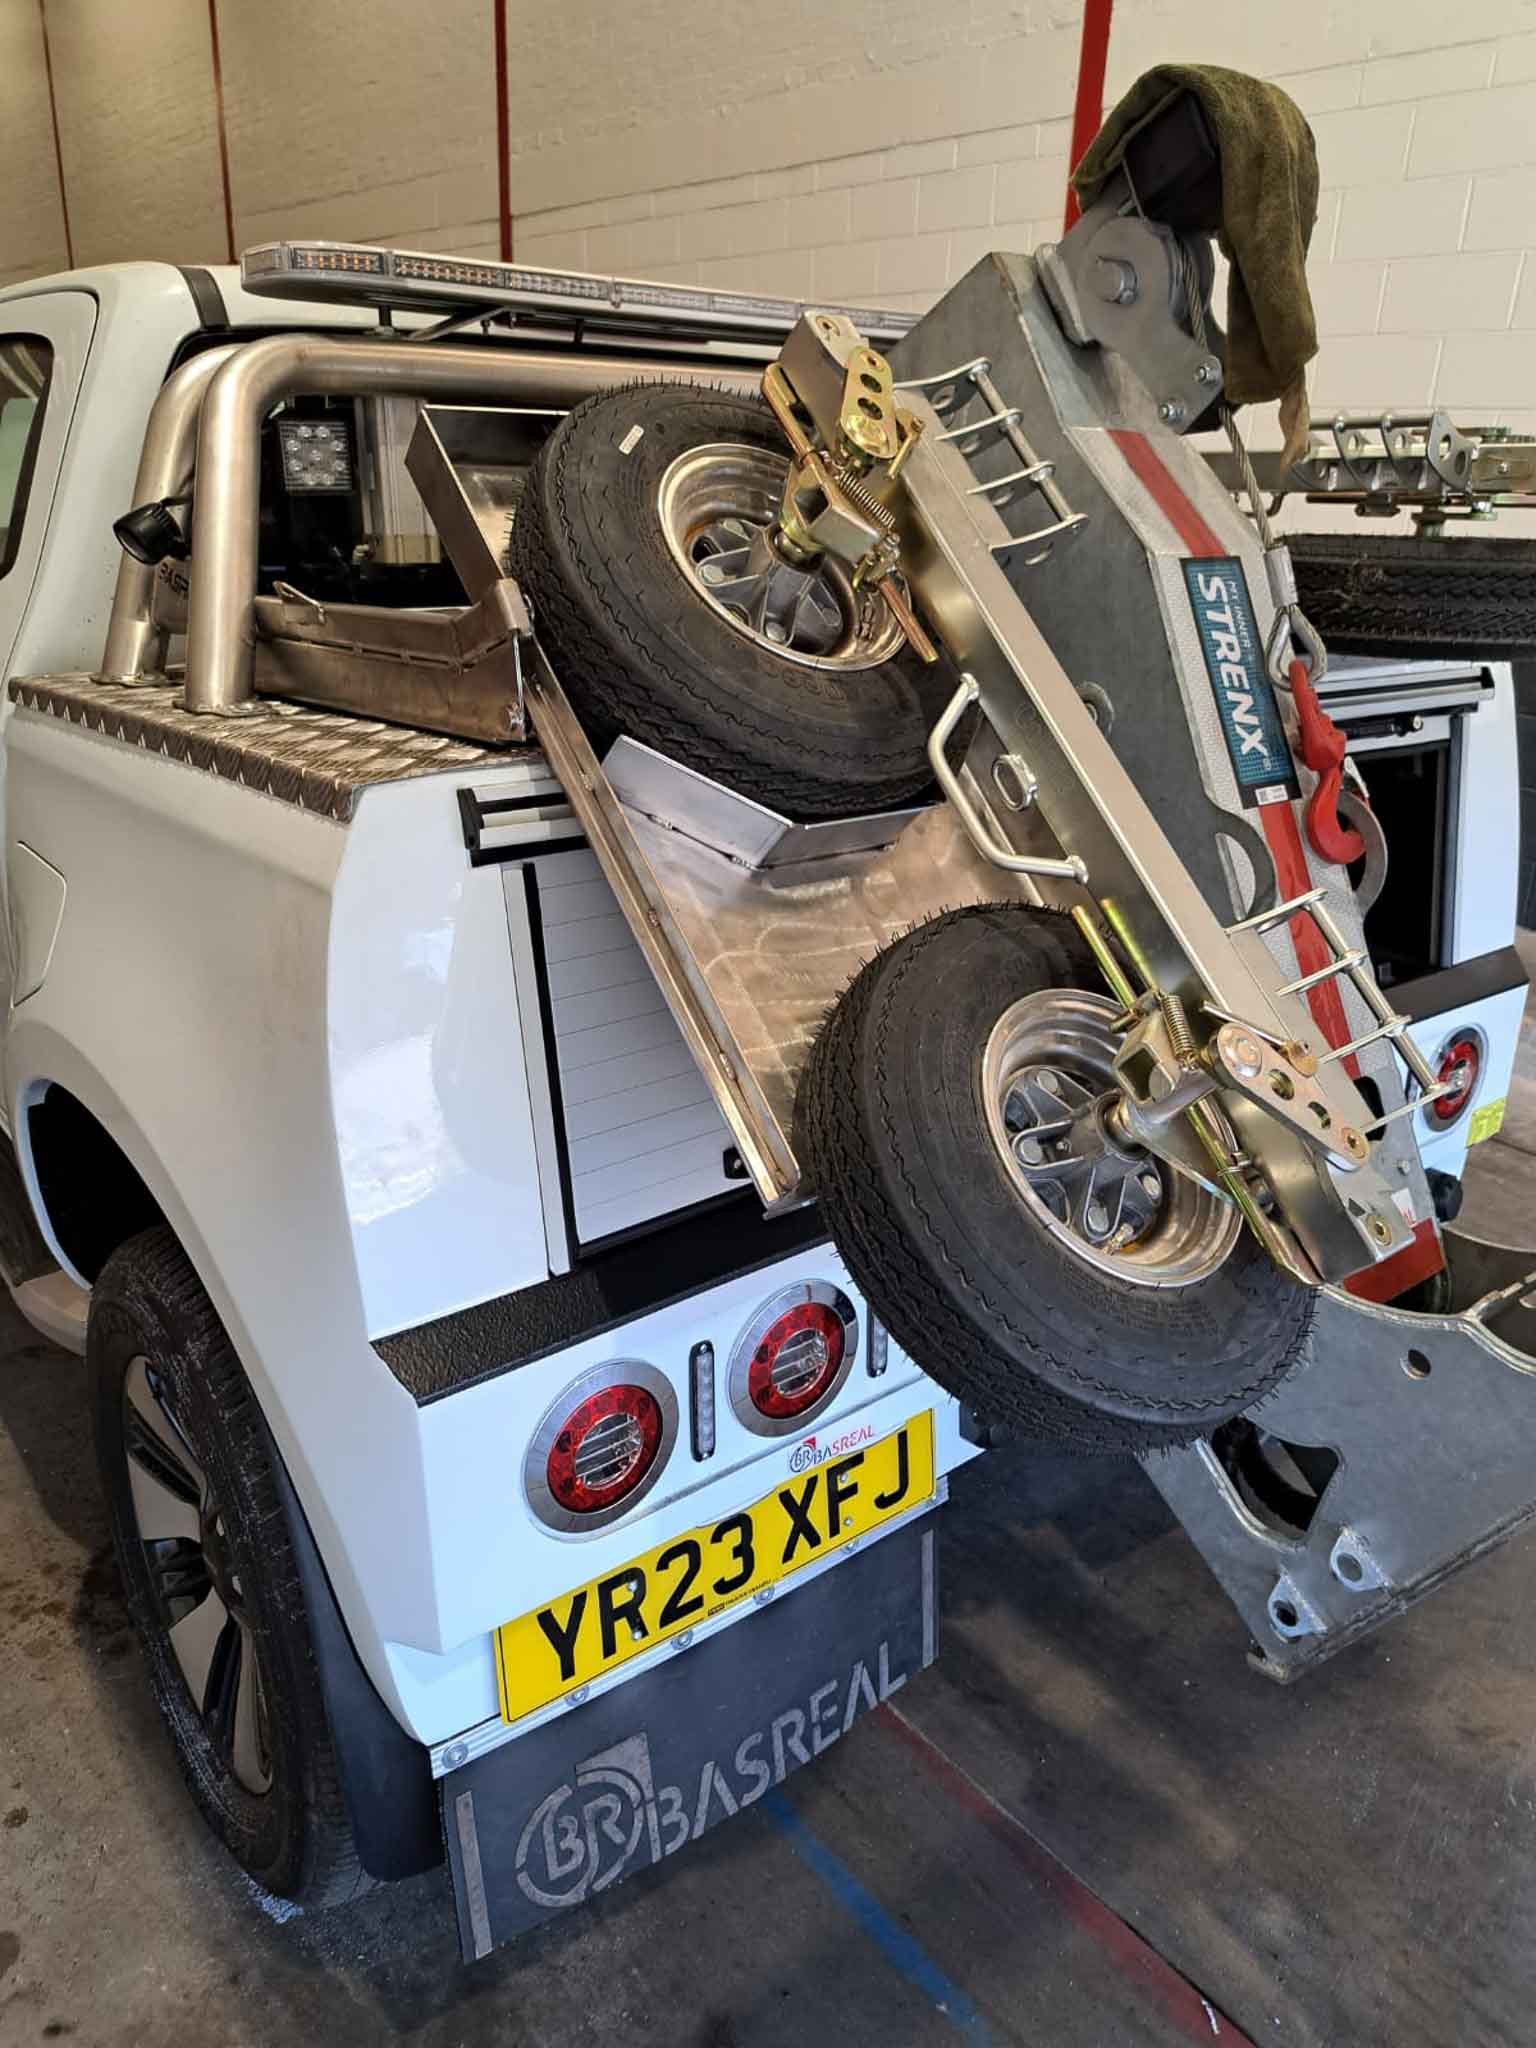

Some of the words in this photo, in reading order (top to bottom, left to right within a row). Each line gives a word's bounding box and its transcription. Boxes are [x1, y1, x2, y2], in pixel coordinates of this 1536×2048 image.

[1235, 606, 1251, 648] INNER
[812, 1425, 873, 1464] BASREAL
[536, 1513, 754, 1681] YR23
[778, 1430, 910, 1564] XFJ
[646, 1641, 908, 1865] BASREAL
